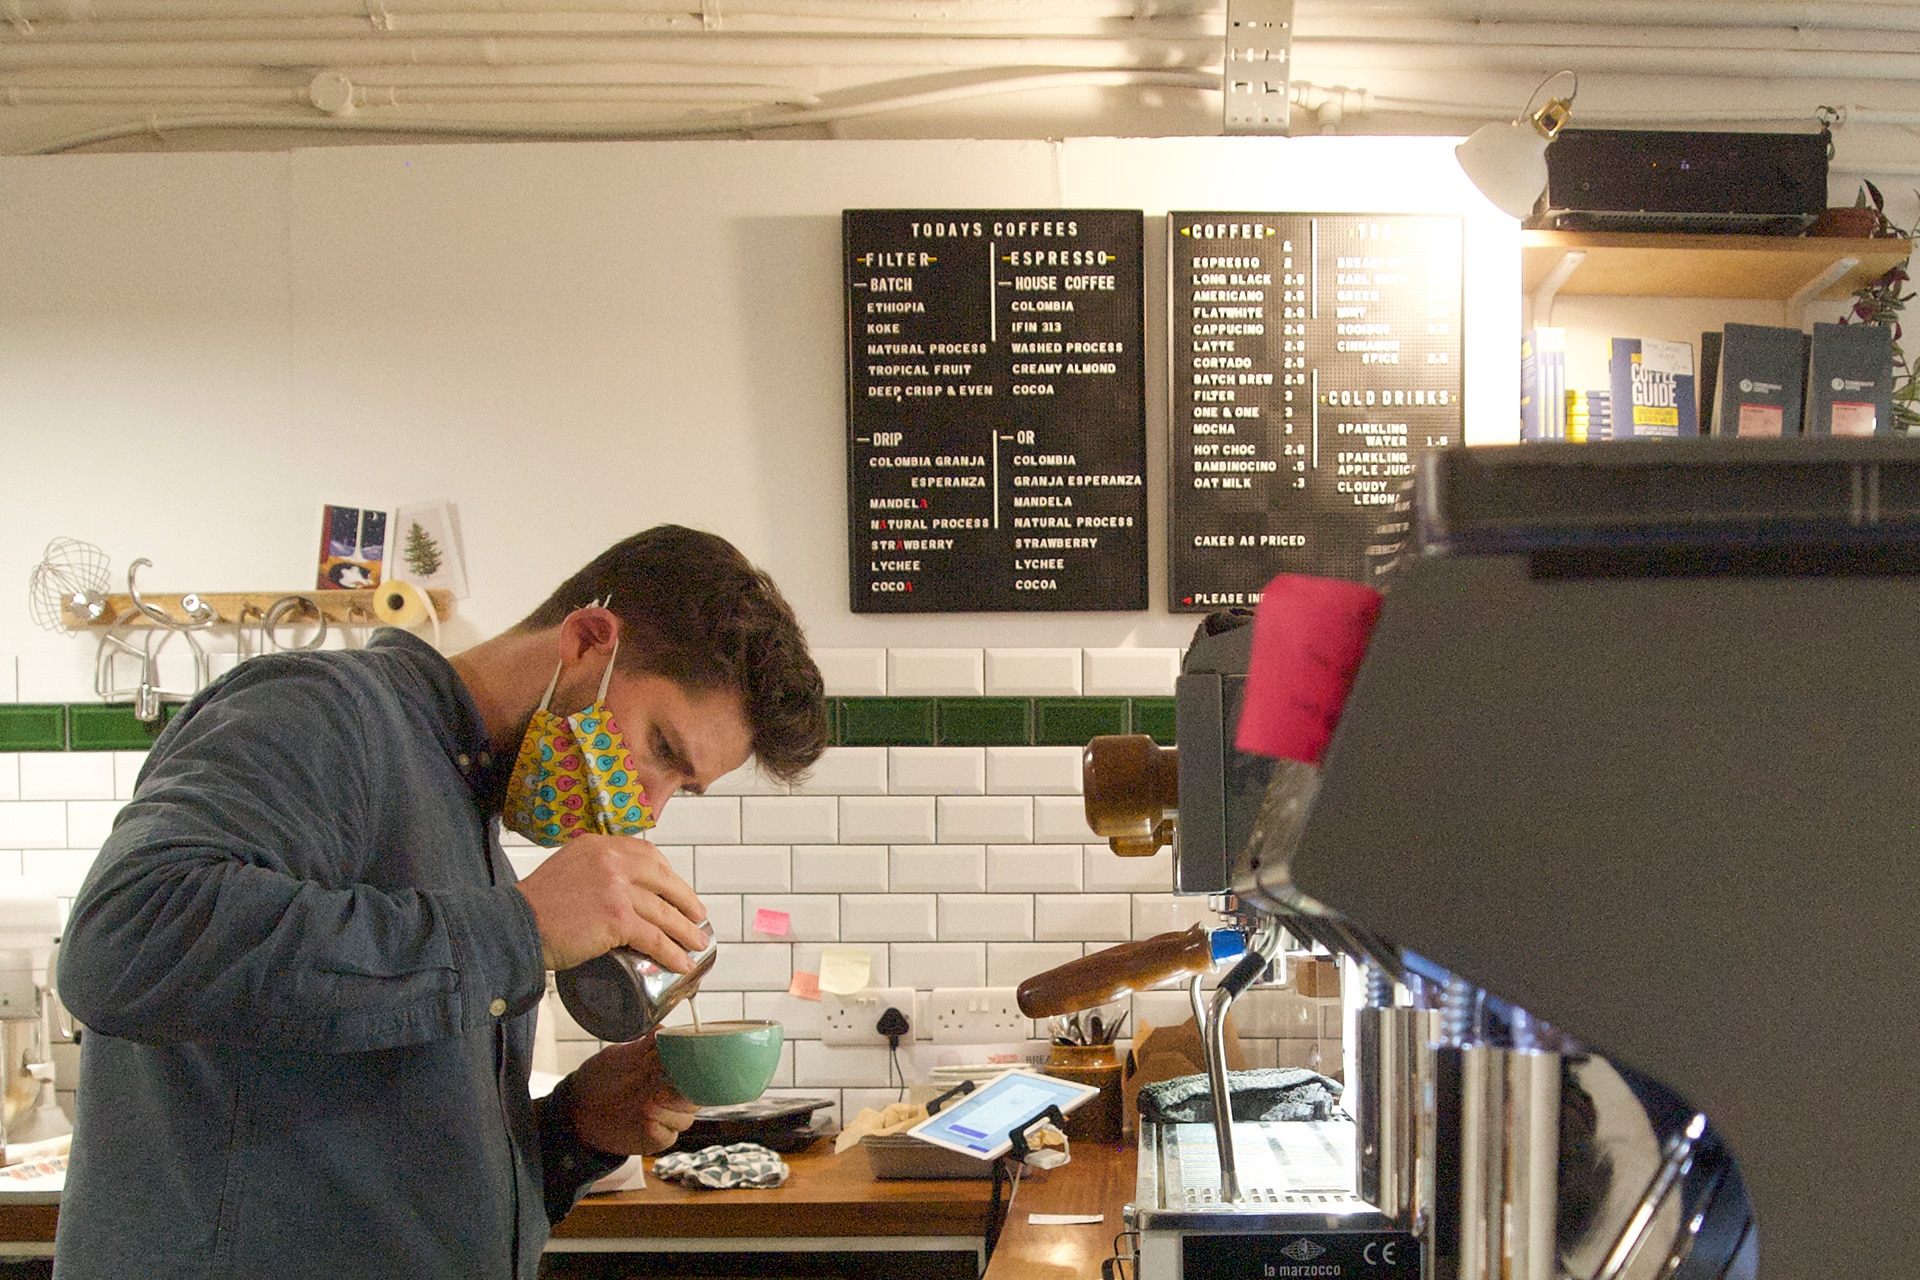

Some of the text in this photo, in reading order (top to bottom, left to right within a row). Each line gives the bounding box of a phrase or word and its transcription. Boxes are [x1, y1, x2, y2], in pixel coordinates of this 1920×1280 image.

[912, 222, 1077, 236] TODAYS COFFEES
[1193, 225, 1264, 239] COFFEE
[866, 253, 928, 266] FILTER
[1011, 252, 1106, 265] ESPRESSO
[1194, 257, 1259, 268] ESPRESSO
[871, 278, 912, 291] BATCH
[1016, 276, 1114, 290] HOUSE COFFEE
[1194, 274, 1226, 285] LONG
[1231, 274, 1271, 285] BLACK
[1194, 291, 1263, 301] AMERICANO
[868, 303, 924, 312] ETHIOPIA
[1012, 301, 1073, 311] COLOMBIA
[1194, 307, 1263, 318] FLATWHITE
[868, 324, 899, 333] KOKE
[1012, 322, 1061, 332] IFIN 313
[1194, 324, 1264, 334] CAPPUCINO
[868, 344, 986, 354] NATURAL PROCESS
[1012, 343, 1122, 352] WASHED PROCESS
[1194, 341, 1234, 351] LATTE
[1194, 358, 1251, 368] CORTADO
[1363, 353, 1398, 364] SPICE
[869, 365, 971, 375] TROPICAL FRUIT
[1013, 364, 1116, 373] CREAMY ALMOND
[1194, 374, 1235, 384] BATCH
[1239, 374, 1272, 384] BREW
[906, 386, 942, 395] CRISP
[948, 386, 955, 395] &
[960, 386, 992, 395] EVEN
[1013, 385, 1054, 394] COCOA
[1632, 382, 1677, 407] GUIDE
[1195, 391, 1292, 401] FILTER 3
[1329, 390, 1450, 405] COLD DRINKS
[1194, 407, 1292, 417] ONE & ONE 3
[1194, 424, 1292, 434] MOCHA 3
[1338, 424, 1407, 434] SPARKLING
[874, 433, 902, 446] DRIP
[1018, 431, 1034, 444] OR
[1366, 436, 1407, 446] WATER
[1195, 445, 1219, 455] HOT
[1223, 445, 1255, 455] CHOC
[870, 456, 984, 466] COLOMBIA GRANJA
[1014, 455, 1075, 465] COLOMBIA
[1338, 453, 1407, 462] SPARKLING
[1195, 462, 1276, 471] BAMBINOCINO
[1338, 465, 1378, 475] APPLE
[912, 477, 985, 487] ESPERANZA
[1014, 476, 1141, 486] GRANJA ESPERANZA
[1194, 478, 1219, 488] OAT
[1223, 478, 1251, 488] MILK
[1338, 481, 1387, 492] CLOUDY
[870, 499, 928, 508] MANDELA
[1014, 497, 1072, 506] MANDELA
[1354, 494, 1400, 504] LEMON
[871, 519, 989, 529] NATURAL PROCESS
[1015, 517, 1132, 527] NATURAL PROCESS
[871, 540, 953, 550] STRAWBERRY
[1016, 538, 1097, 548] STRAWBERRY
[1195, 536, 1305, 546] CAKES AS PRICED
[872, 561, 919, 570] LYCHEE
[1016, 559, 1063, 569] LYCHEE
[872, 582, 912, 592] COCOA
[1016, 580, 1056, 589] COCOA
[1195, 594, 1243, 603] PLEASE
[1364, 1242, 1395, 1265] CE
[1280, 1265, 1340, 1276] marzocco
